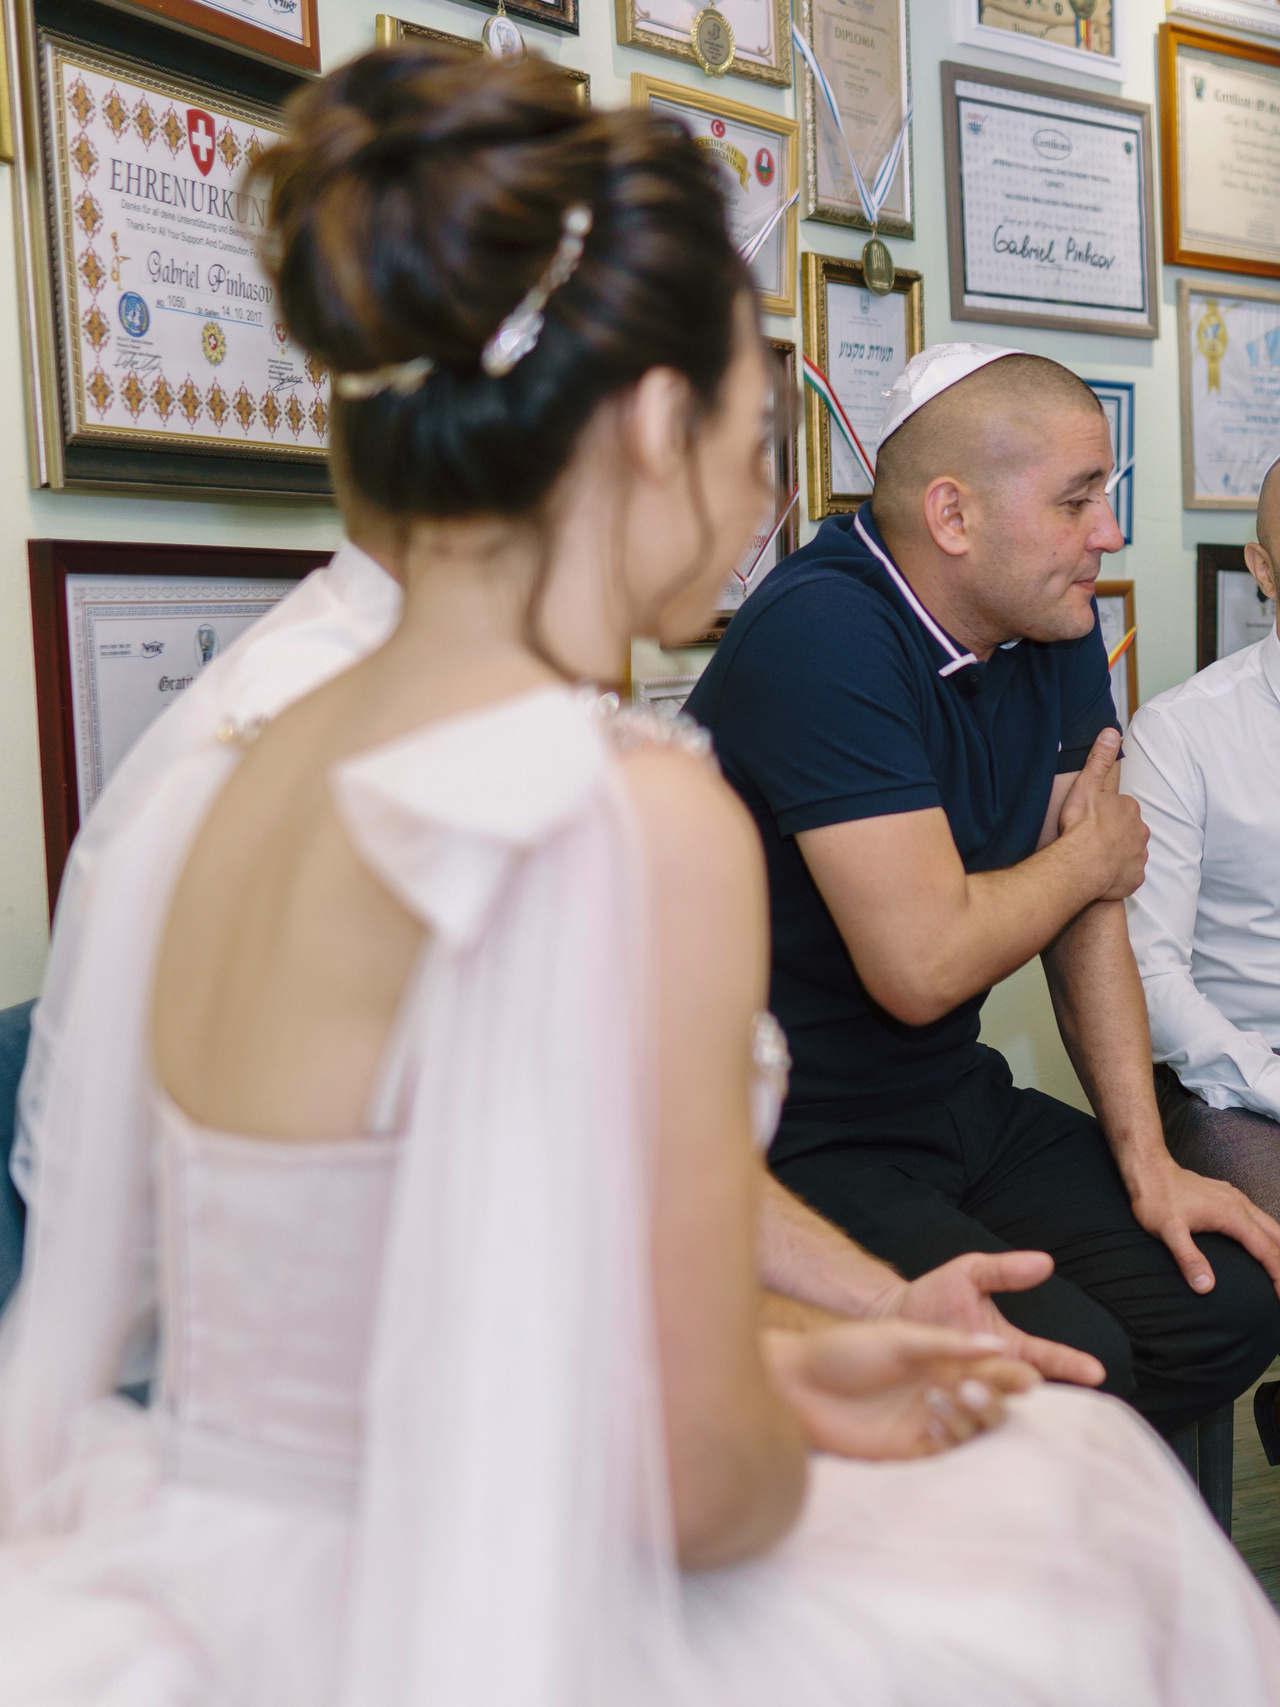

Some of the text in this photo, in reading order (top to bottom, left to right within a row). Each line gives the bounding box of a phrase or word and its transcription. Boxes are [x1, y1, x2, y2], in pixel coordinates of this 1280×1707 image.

[834, 26, 876, 50] DIPLOMA
[696, 138, 739, 158] CERTIFICATE
[703, 148, 745, 174] PPRECIATION
[110, 157, 273, 229] EHRENURKUN
[121, 199, 142, 213] Danke
[152, 206, 160, 217] all
[218, 223, 228, 233] und
[126, 218, 146, 233] Thank
[146, 224, 157, 235] For
[158, 226, 166, 236] All
[167, 227, 181, 240] Your
[181, 231, 205, 246] Support
[205, 236, 218, 249] And
[218, 240, 249, 257] Contribution
[992, 224, 1056, 264] Gabriel
[147, 250, 273, 304] Gabriel Pinhasov
[167, 294, 187, 309] 1050
[246, 309, 263, 323] 2017
[838, 340, 894, 364] תעודת מקצוע
[157, 674, 198, 692] Gratit
